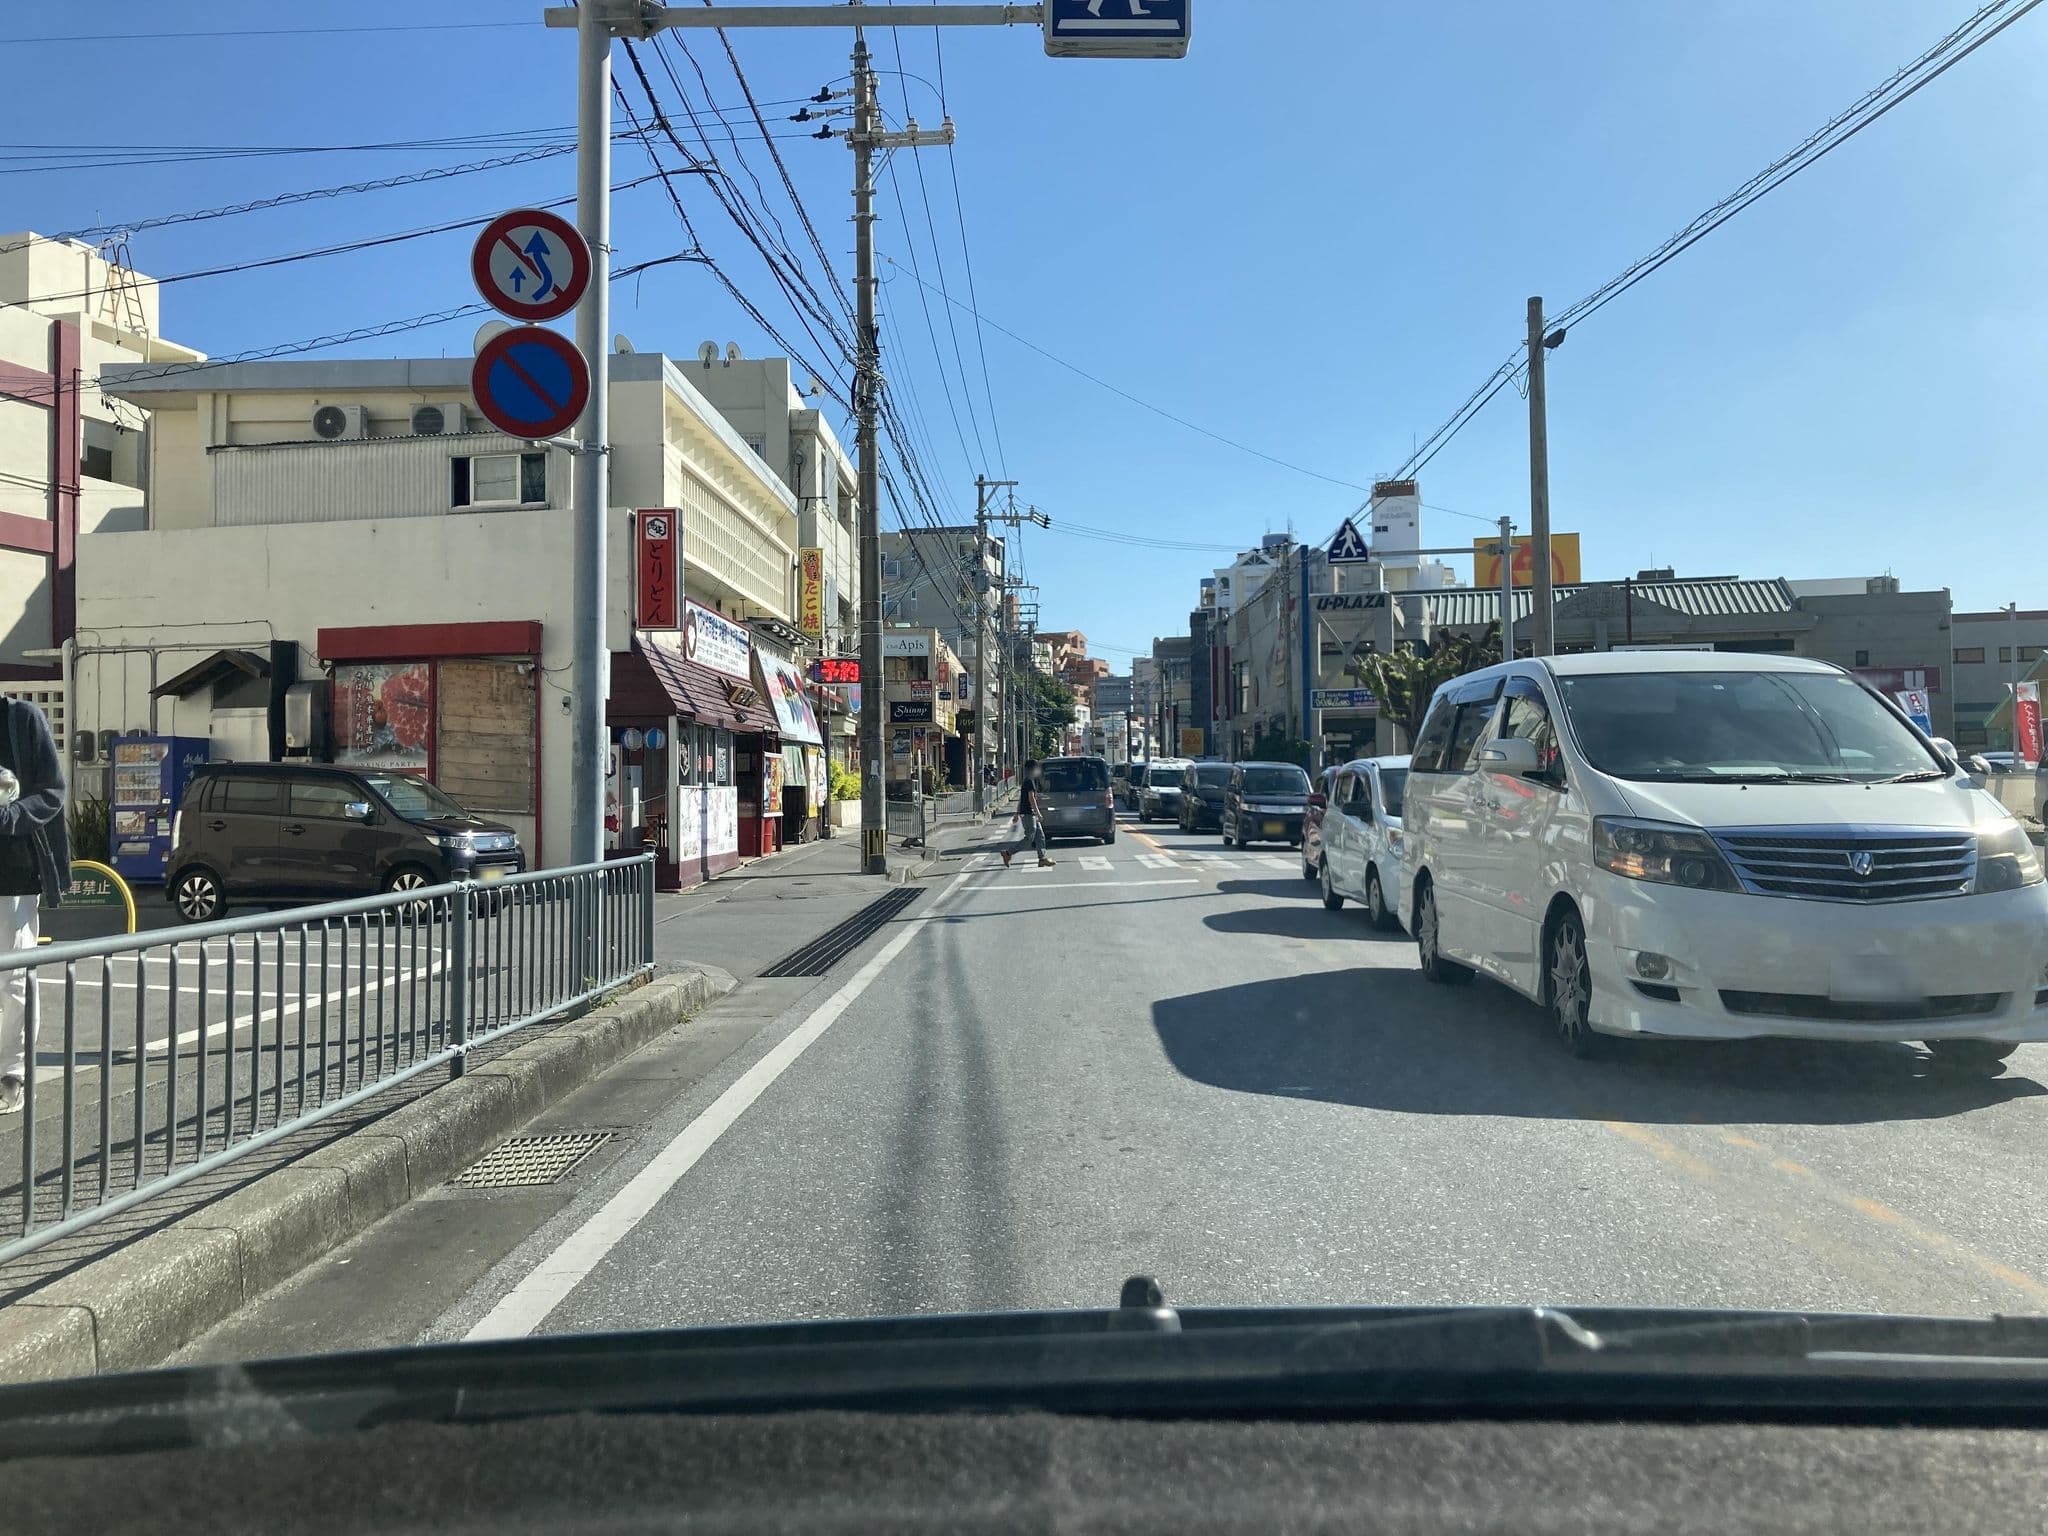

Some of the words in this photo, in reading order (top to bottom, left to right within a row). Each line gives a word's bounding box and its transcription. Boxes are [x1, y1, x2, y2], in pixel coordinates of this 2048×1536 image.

[649, 541, 665, 623] とりとん
[898, 639, 925, 653] Apis
[820, 660, 860, 683] 予約
[894, 704, 928, 718] Shinny
[61, 879, 111, 896] 車禁止
